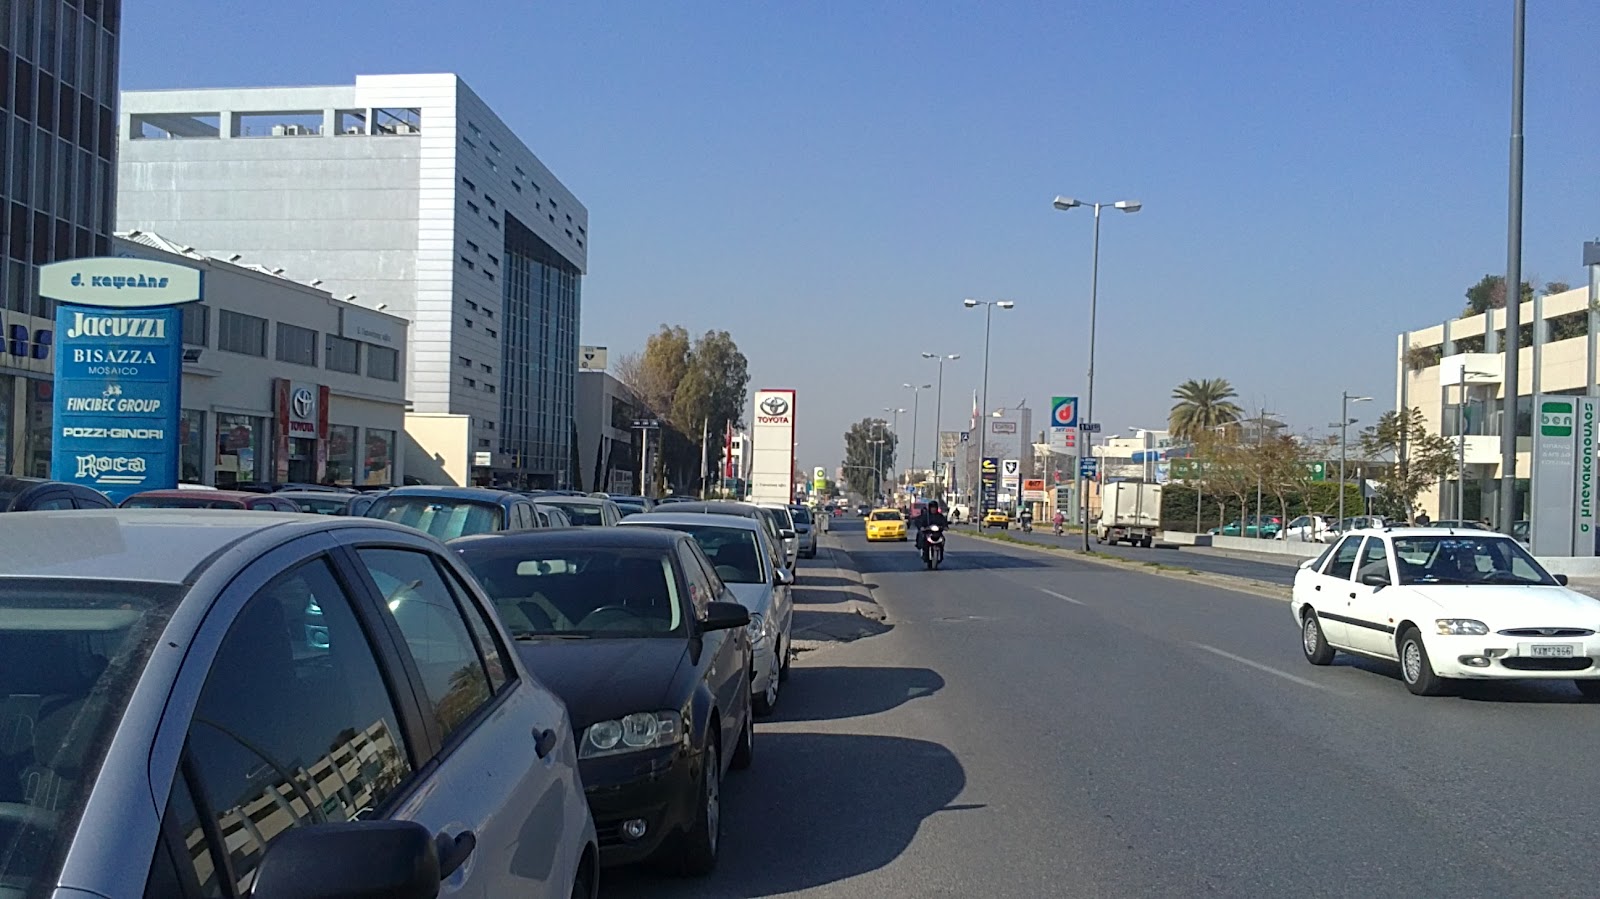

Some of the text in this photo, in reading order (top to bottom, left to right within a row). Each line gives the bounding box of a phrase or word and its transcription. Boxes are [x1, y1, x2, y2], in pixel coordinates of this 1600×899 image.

[67, 312, 166, 338] Jacuzzi
[74, 349, 156, 364] BISAZZA
[88, 366, 138, 375] MOSAICO
[67, 397, 161, 412] FINCIBEC GROUP
[1541, 413, 1572, 425] ben
[63, 427, 164, 439] POZZI-GINORI
[290, 421, 314, 432] TOYOTA
[75, 454, 147, 478] Roca
